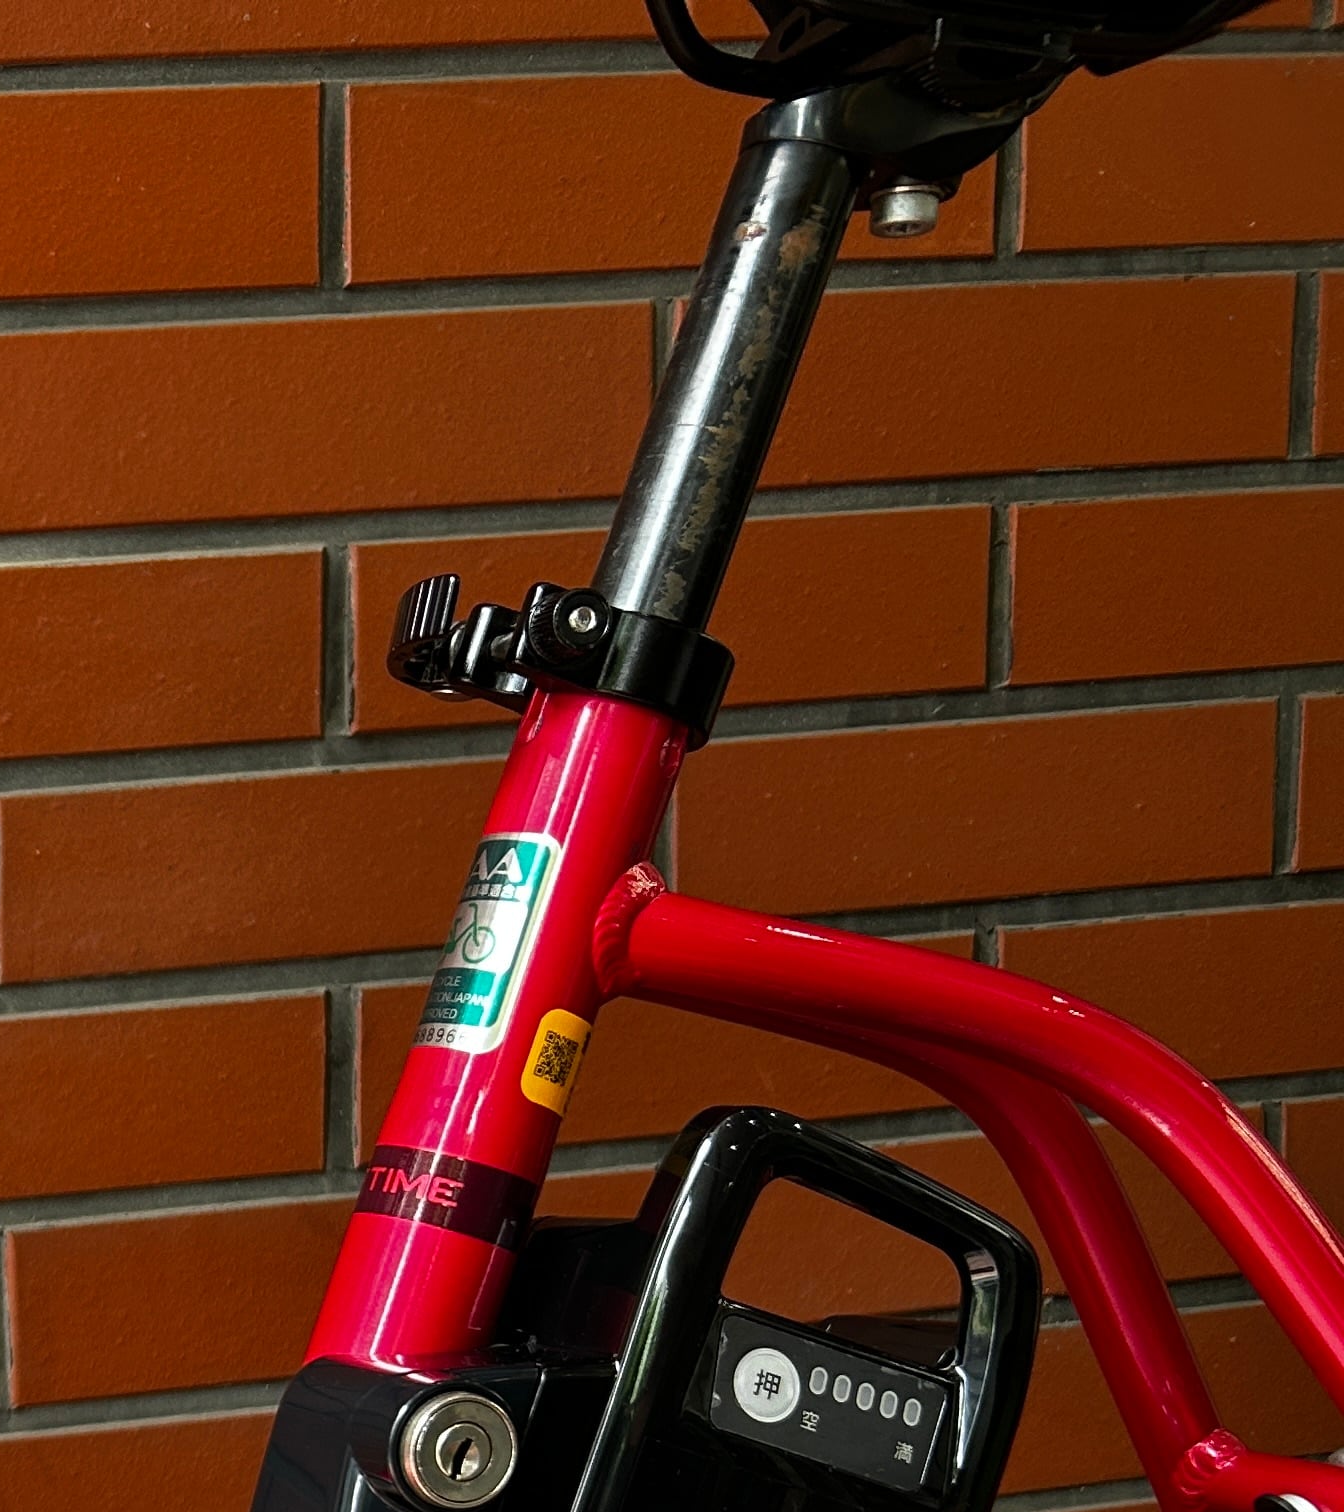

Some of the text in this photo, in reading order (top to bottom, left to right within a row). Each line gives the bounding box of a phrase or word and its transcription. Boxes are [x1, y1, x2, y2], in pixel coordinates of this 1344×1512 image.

[753, 1368, 782, 1400] 押
[800, 1410, 820, 1433] 空
[894, 1441, 914, 1464] 満
